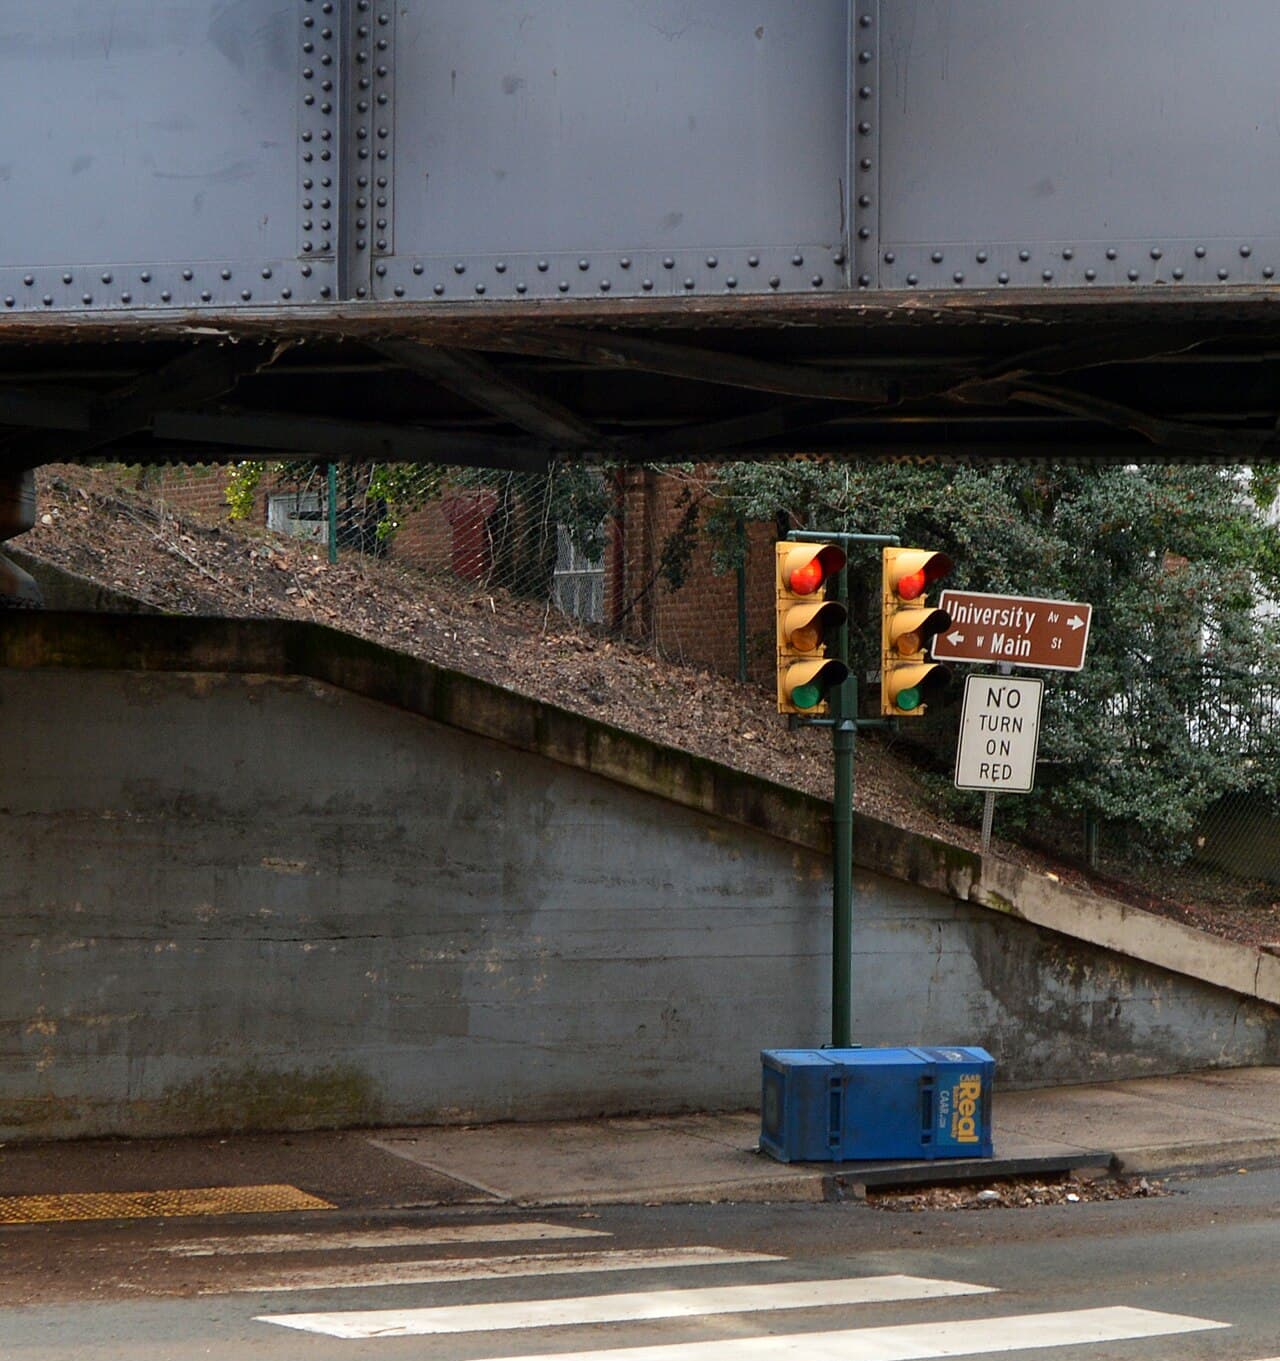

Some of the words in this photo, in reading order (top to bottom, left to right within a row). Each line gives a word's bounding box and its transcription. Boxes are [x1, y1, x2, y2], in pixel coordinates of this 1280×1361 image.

[947, 600, 1036, 634] University
[1048, 611, 1059, 624] Av
[976, 635, 985, 647] W
[990, 632, 1032, 657] Main
[1051, 637, 1062, 649] St
[987, 687, 1021, 709] NO
[979, 715, 1023, 734] TURN
[986, 739, 1010, 756] ON
[980, 763, 1012, 780] RED
[957, 1081, 981, 1143] Real
